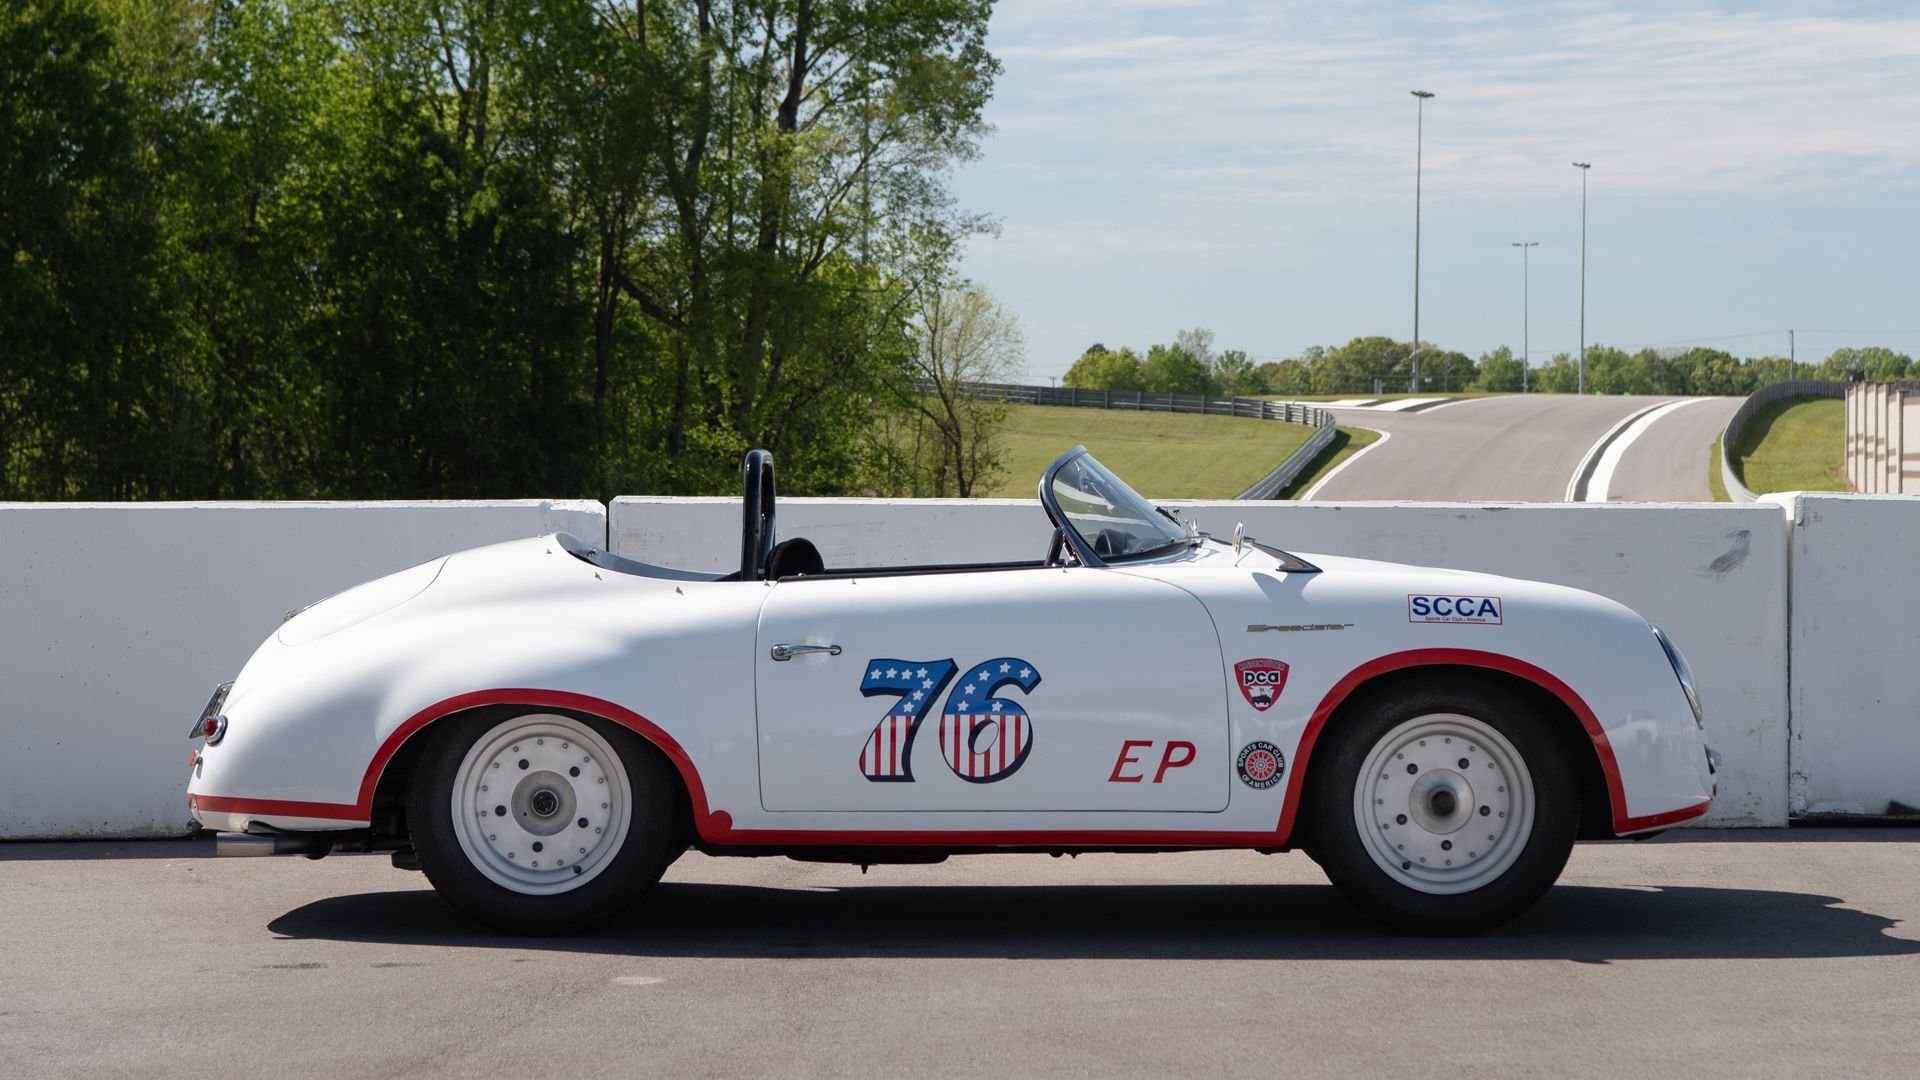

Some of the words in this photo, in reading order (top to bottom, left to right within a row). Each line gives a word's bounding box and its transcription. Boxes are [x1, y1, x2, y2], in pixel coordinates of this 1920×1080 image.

[1412, 596, 1499, 617] SCCA
[1243, 671, 1280, 686] pca
[859, 657, 1042, 784] 76
[1108, 740, 1196, 783] EP
[1238, 743, 1257, 767] SPORTS
[1258, 743, 1274, 751] CAR
[1272, 749, 1284, 768] CLUB
[1248, 772, 1282, 788] AMERICA
